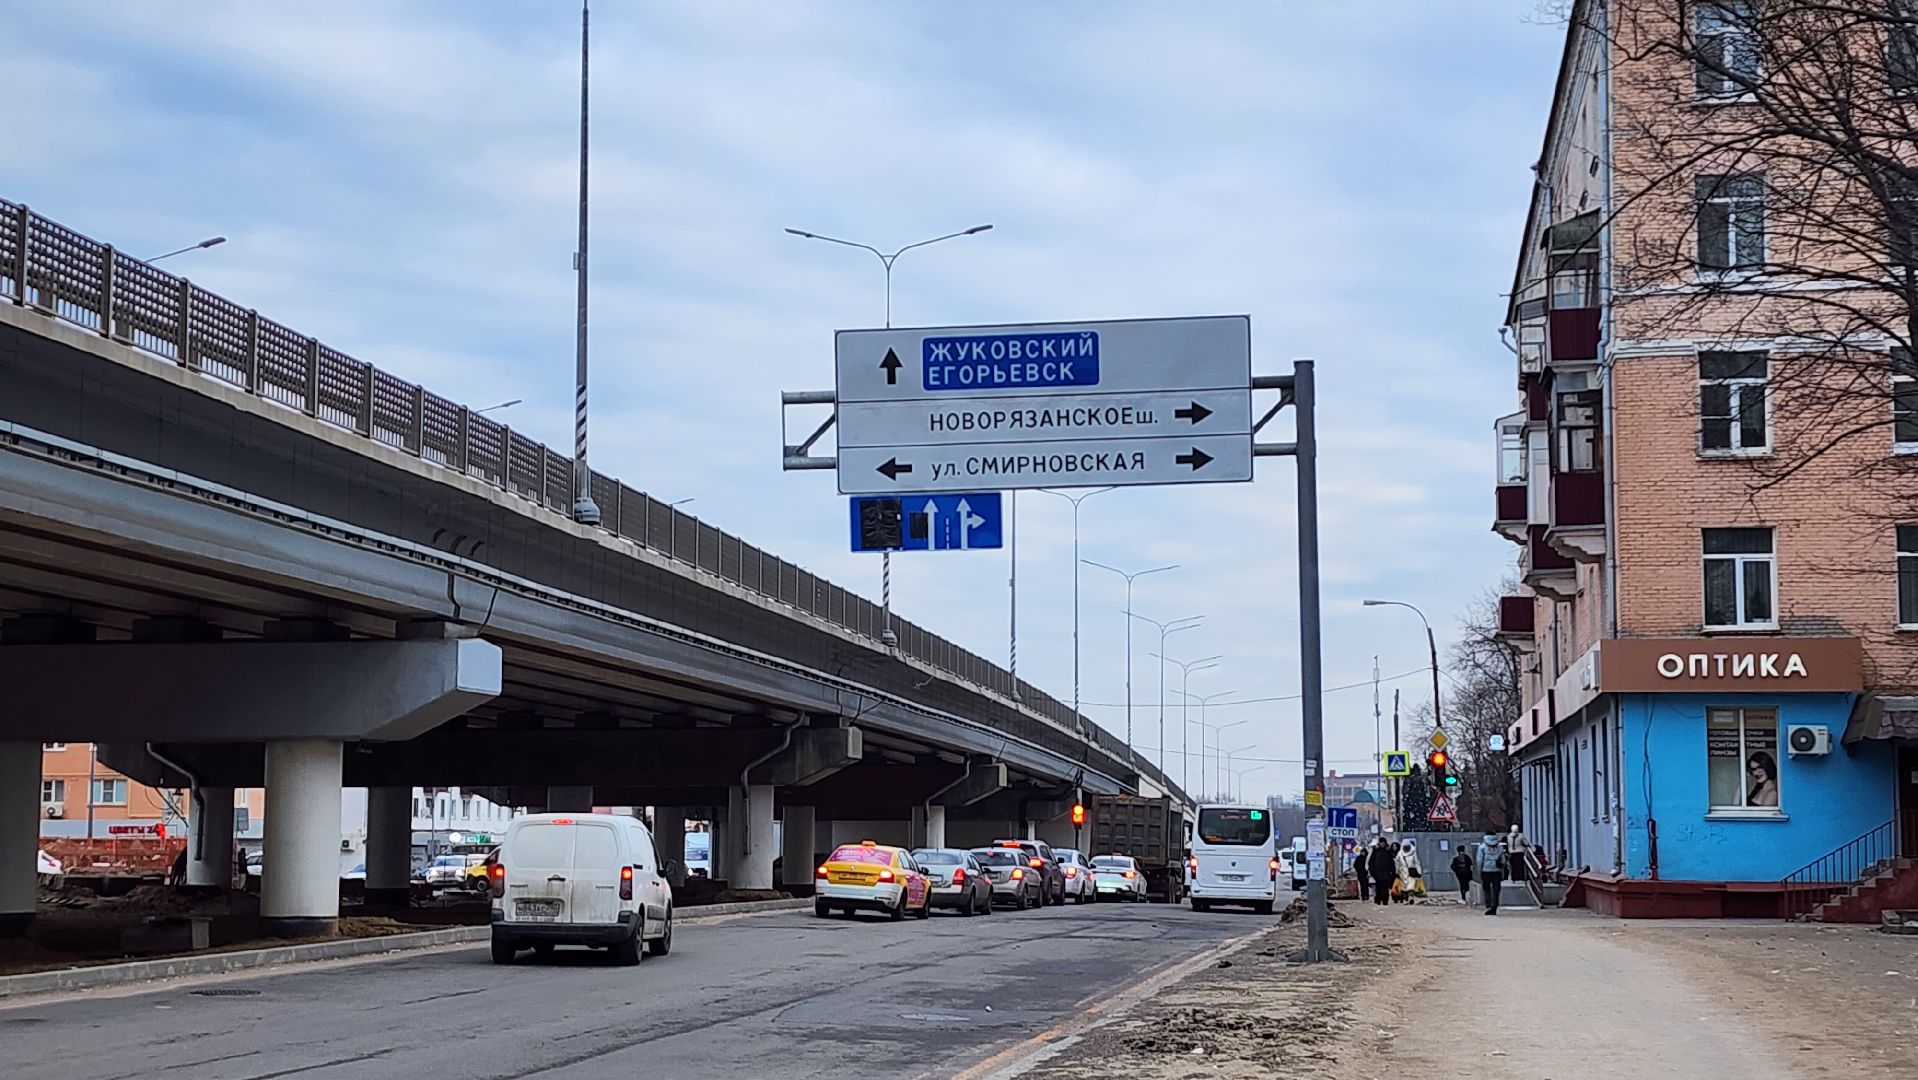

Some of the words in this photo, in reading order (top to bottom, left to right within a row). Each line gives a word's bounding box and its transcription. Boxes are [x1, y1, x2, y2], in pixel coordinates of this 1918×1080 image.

[929, 332, 1094, 362] ЖУКОВСКИЙ
[928, 361, 1075, 385] ЕГОРЬЕВСК
[932, 463, 961, 481] ул.
[966, 452, 1145, 476] СМИРНОВСКАЯ
[1657, 653, 1808, 678] ОПТИКА
[1331, 828, 1355, 837] СТОП
